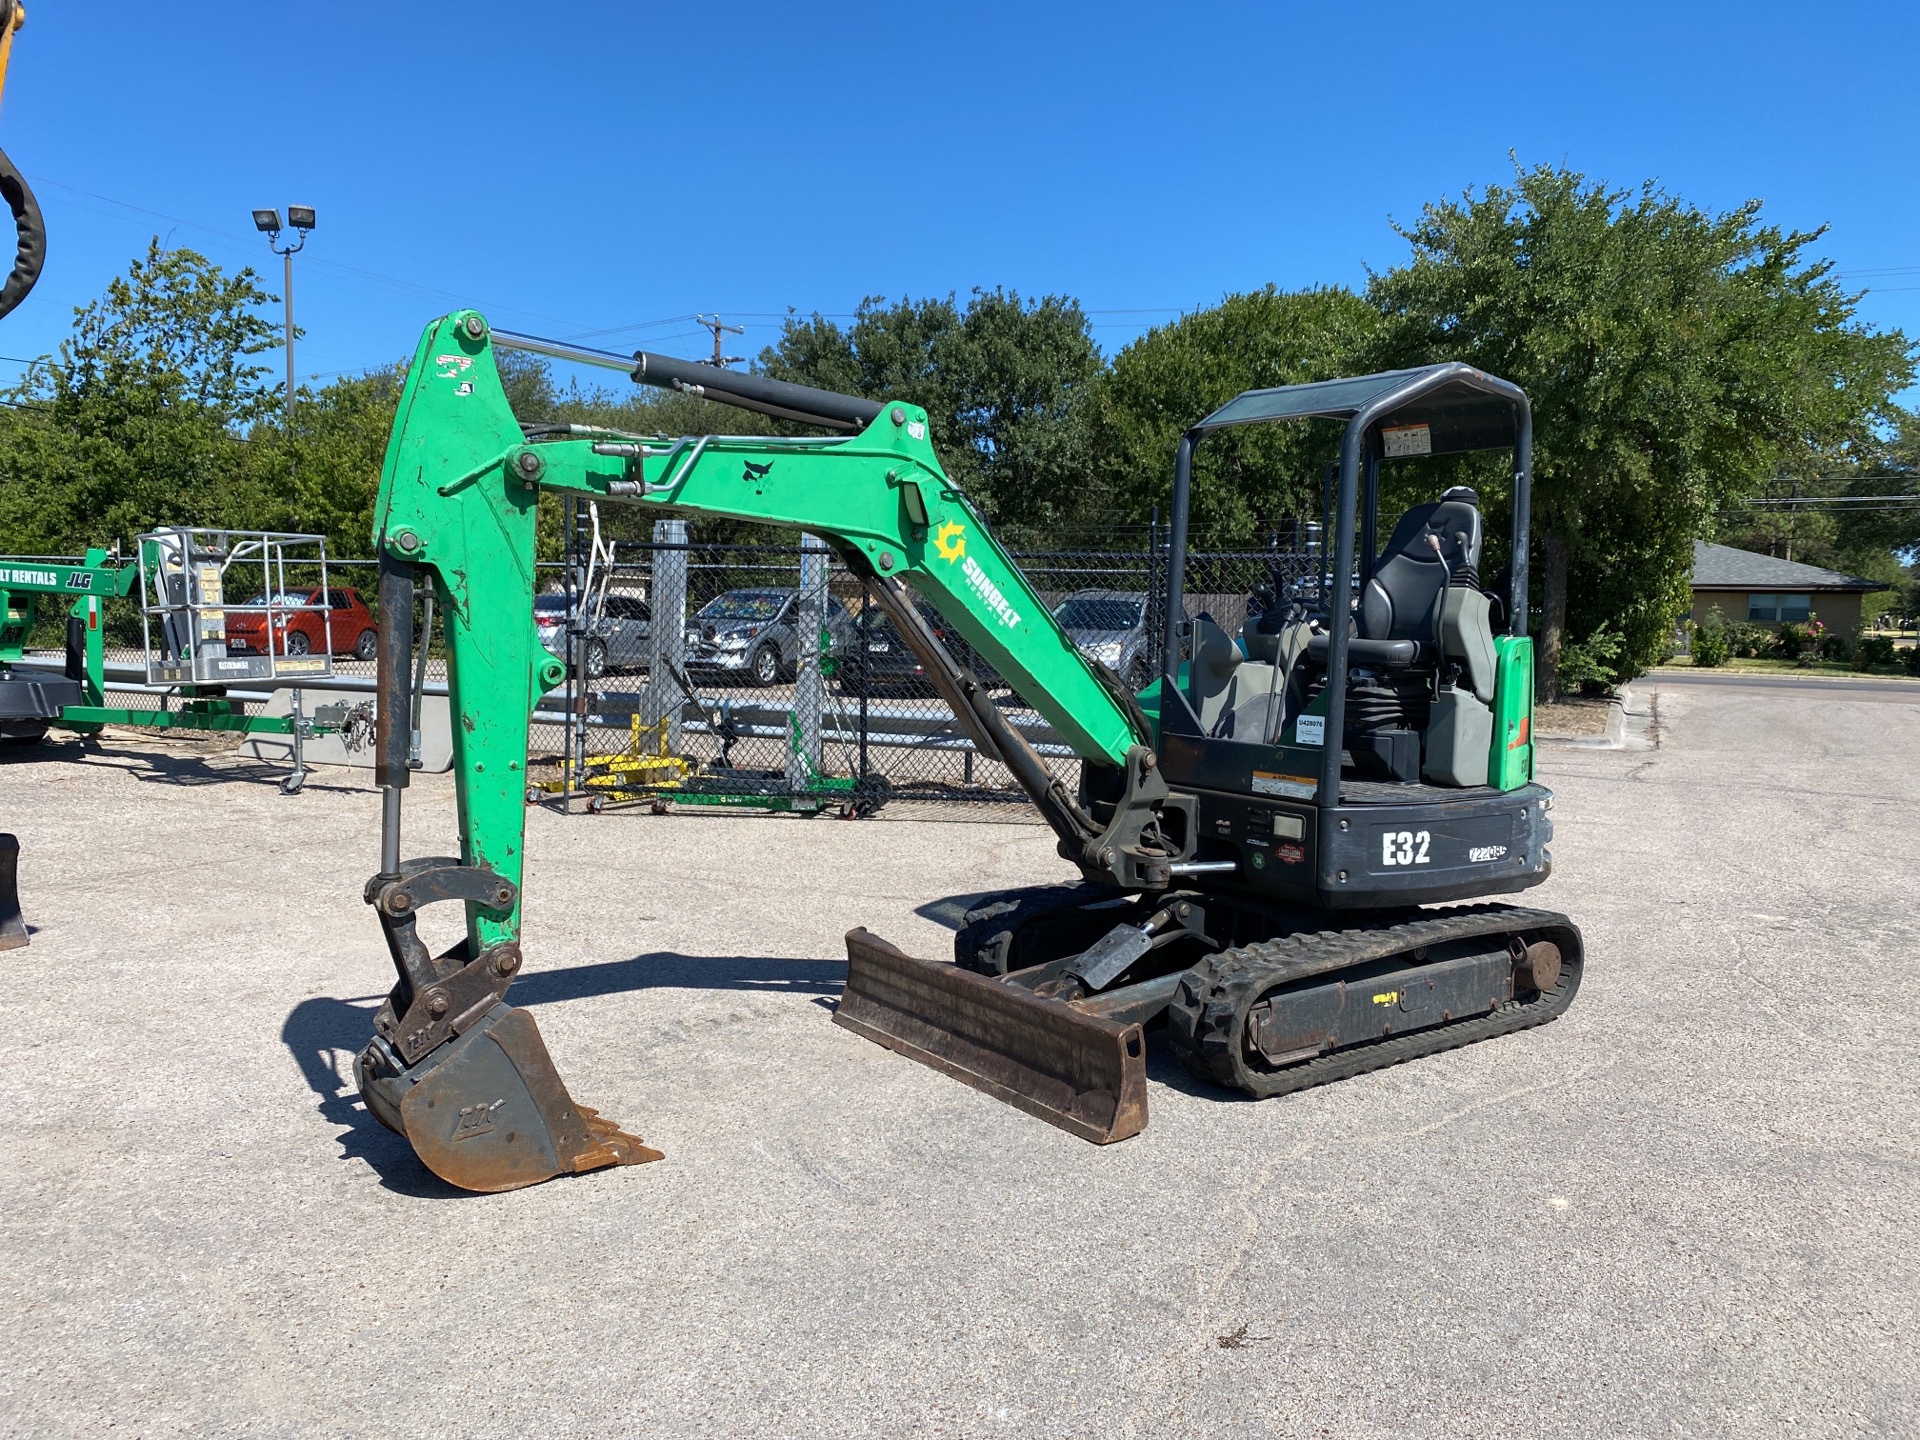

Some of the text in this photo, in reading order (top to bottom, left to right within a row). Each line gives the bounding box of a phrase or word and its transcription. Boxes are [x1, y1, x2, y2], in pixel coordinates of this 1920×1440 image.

[12, 569, 57, 586] RENTALS
[65, 572, 93, 589] JLG
[962, 556, 1021, 628] SUNBELT
[965, 578, 1004, 626] RENTALS
[1382, 830, 1431, 866] E32
